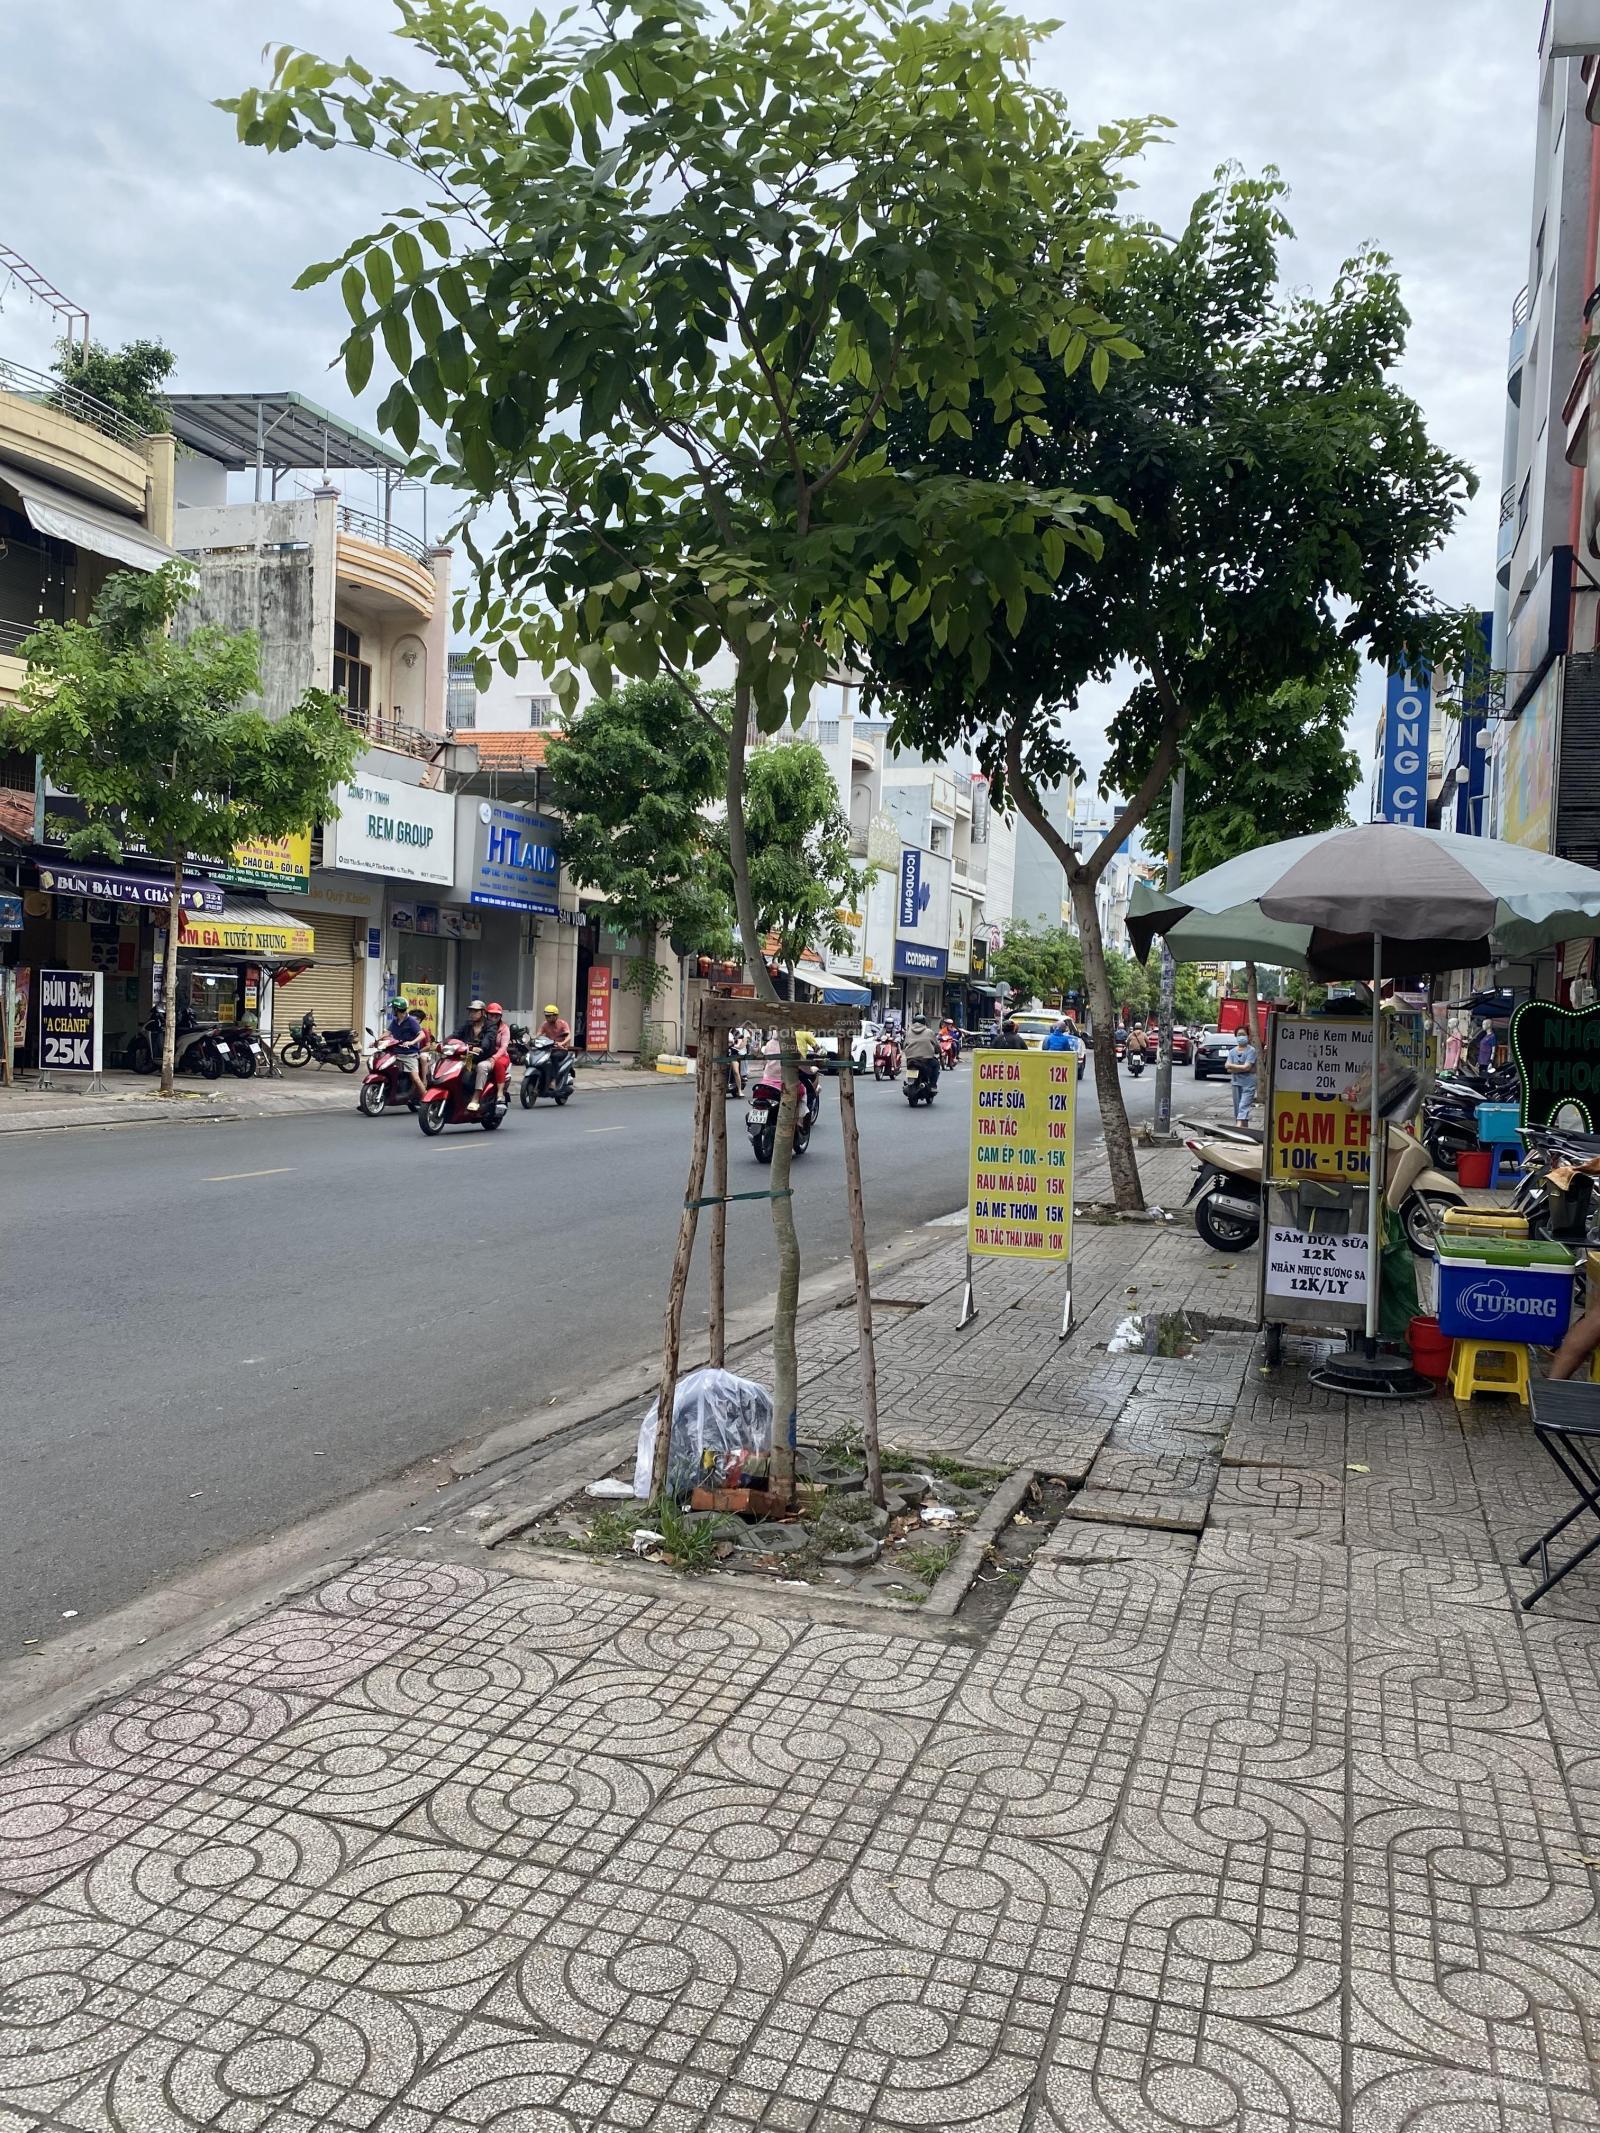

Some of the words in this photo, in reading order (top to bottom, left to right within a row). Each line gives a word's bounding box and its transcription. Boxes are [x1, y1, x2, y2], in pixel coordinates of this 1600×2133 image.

[368, 814, 394, 841] REM
[397, 820, 434, 848] GROUP
[57, 874, 88, 893] BÚN
[92, 880, 123, 898] ĐẬU
[203, 928, 220, 946] GÀ
[224, 926, 253, 948] TUYẾT
[256, 934, 286, 949] NHUNG
[43, 977, 66, 1007] BÚN
[1300, 1028, 1319, 1041] Phê
[1324, 1030, 1347, 1042] Kem
[44, 1038, 90, 1066] 25K
[1320, 1044, 1338, 1057] 15k
[980, 1061, 1004, 1080] CAFÉ
[1006, 1061, 1020, 1080] ĐÁ
[1050, 1066, 1068, 1082] 12K
[1280, 1058, 1312, 1071] Cacao
[1316, 1060, 1340, 1072] Kem
[1316, 1076, 1336, 1088] 20k
[978, 1088, 1004, 1108] CAFÉ
[1006, 1089, 1026, 1108] SỮA
[1049, 1094, 1067, 1110] 12K
[978, 1116, 996, 1135] TRÀ
[998, 1114, 1018, 1136] TẮC
[1048, 1122, 1066, 1138] 10K
[1278, 1112, 1335, 1144] CAM
[977, 1146, 999, 1162] CAM
[1002, 1144, 1014, 1164] ÉP
[1018, 1149, 1037, 1165] 10K
[1047, 1150, 1066, 1166] 15K
[1280, 1148, 1318, 1170] 10k
[976, 1173, 996, 1190] RAU
[999, 1172, 1014, 1191] MÁ
[1017, 1173, 1037, 1196] ĐẬU
[1046, 1178, 1064, 1194] 15K
[976, 1198, 989, 1217] ĐÁ
[991, 1202, 1006, 1218] ME
[1010, 1202, 1038, 1220] THƠM
[1046, 1206, 1064, 1222] 15K
[975, 1226, 989, 1244] TRÀ
[990, 1224, 1004, 1246] TẮC
[1006, 1228, 1022, 1247] THÁI
[1024, 1232, 1044, 1248] XANH
[1048, 1234, 1063, 1250] 10K
[1274, 1231, 1304, 1244] SÂM
[1307, 1234, 1338, 1246] DỨA
[1341, 1237, 1368, 1250] SỮA
[1302, 1248, 1336, 1261] 12K
[1297, 1265, 1322, 1278] NHỤC
[1323, 1267, 1352, 1278] SƯƠNG
[1354, 1270, 1366, 1280] SA
[1290, 1278, 1349, 1296] 12K/LY
[1472, 1292, 1557, 1318] TUBORG
